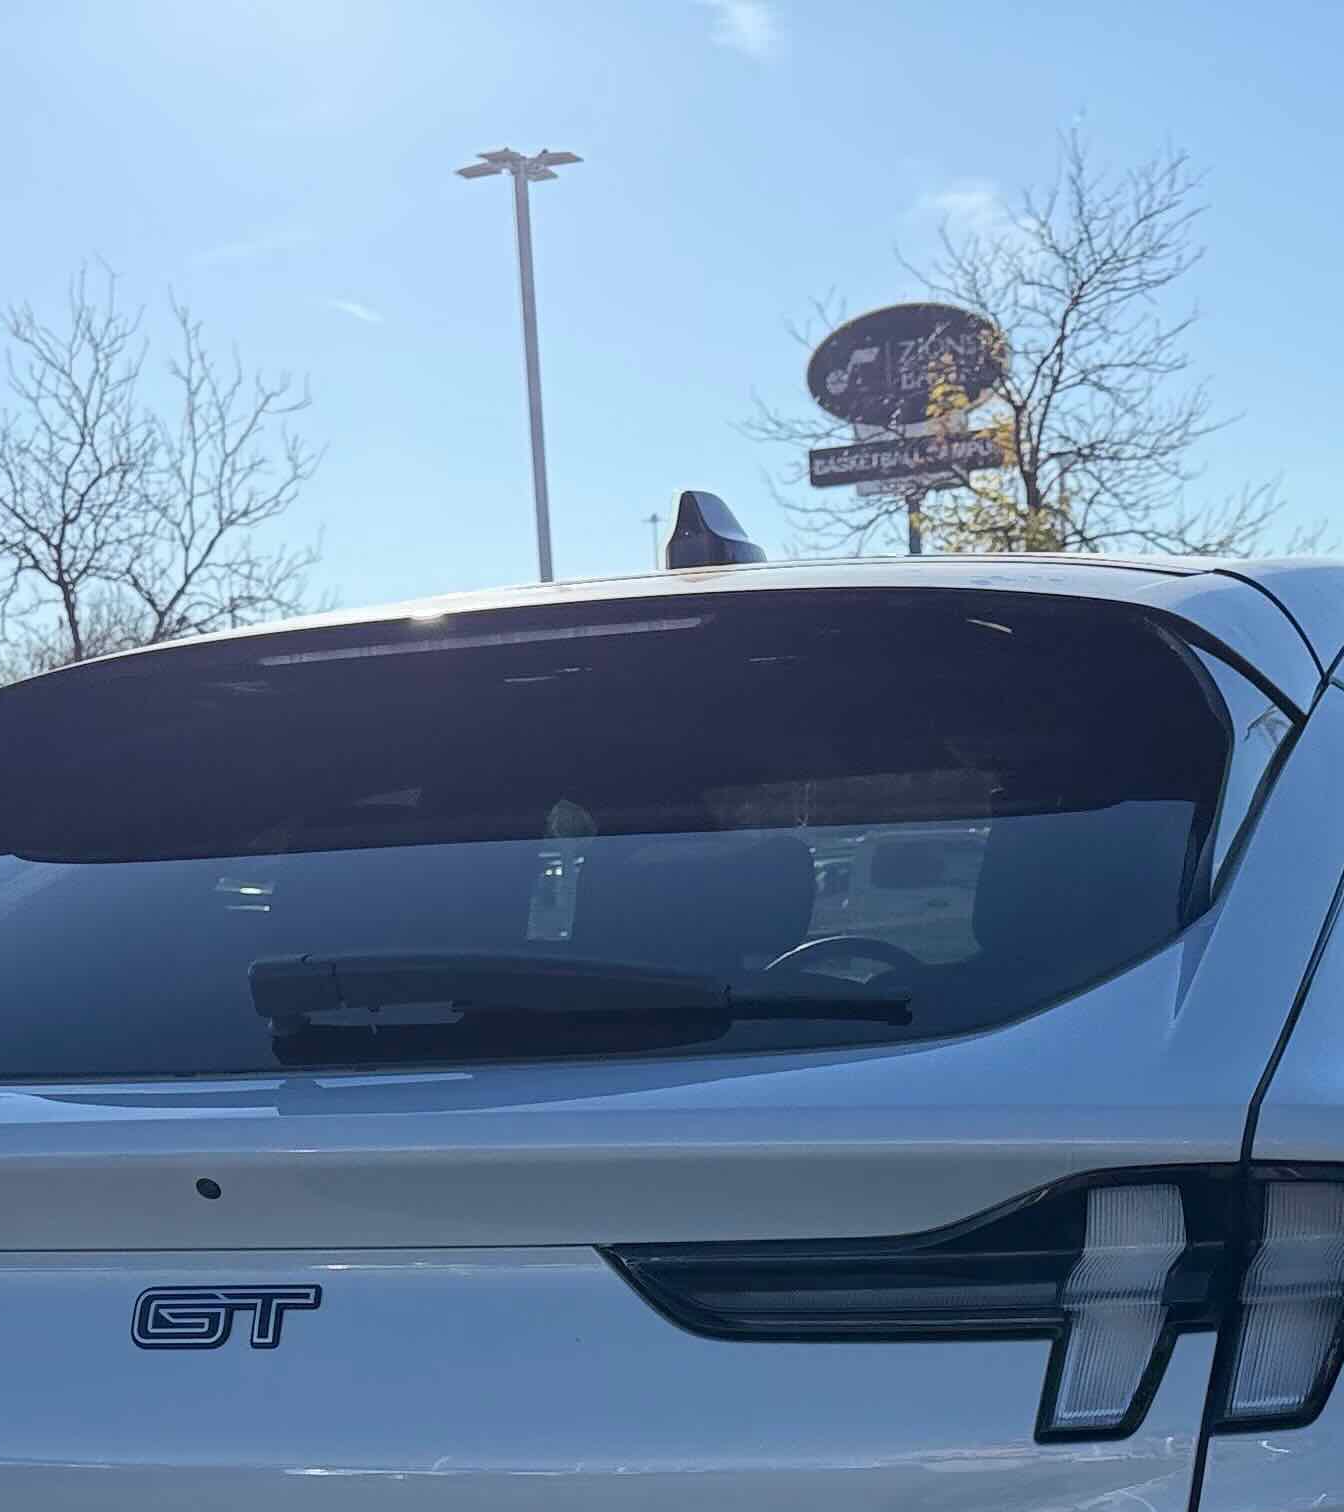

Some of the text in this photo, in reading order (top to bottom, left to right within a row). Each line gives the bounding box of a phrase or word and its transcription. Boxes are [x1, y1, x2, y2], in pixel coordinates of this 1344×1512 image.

[896, 333, 991, 363] ZION
[926, 439, 1003, 463] CAMPU
[131, 1284, 322, 1349] GT
